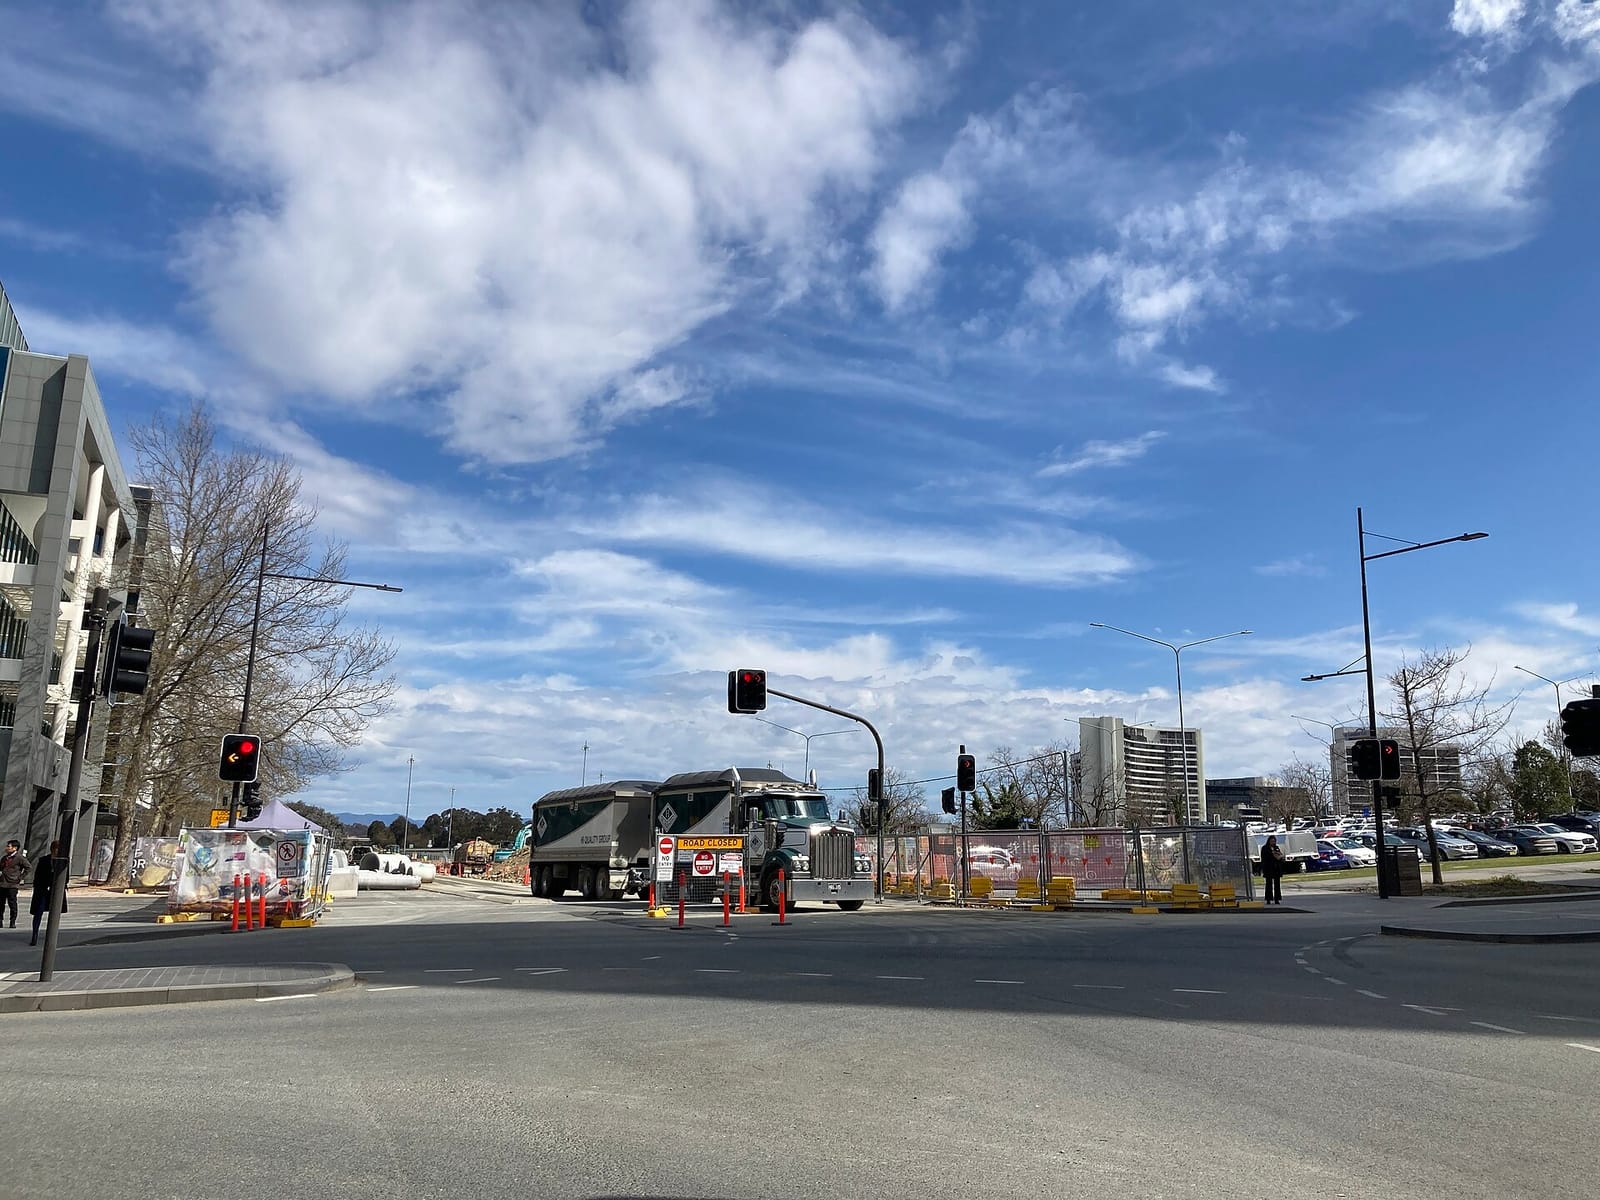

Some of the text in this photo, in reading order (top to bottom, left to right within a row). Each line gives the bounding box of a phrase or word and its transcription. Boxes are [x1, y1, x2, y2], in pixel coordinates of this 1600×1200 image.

[599, 834, 611, 843] GROUP
[683, 838, 738, 847] ROAD CLOSED
